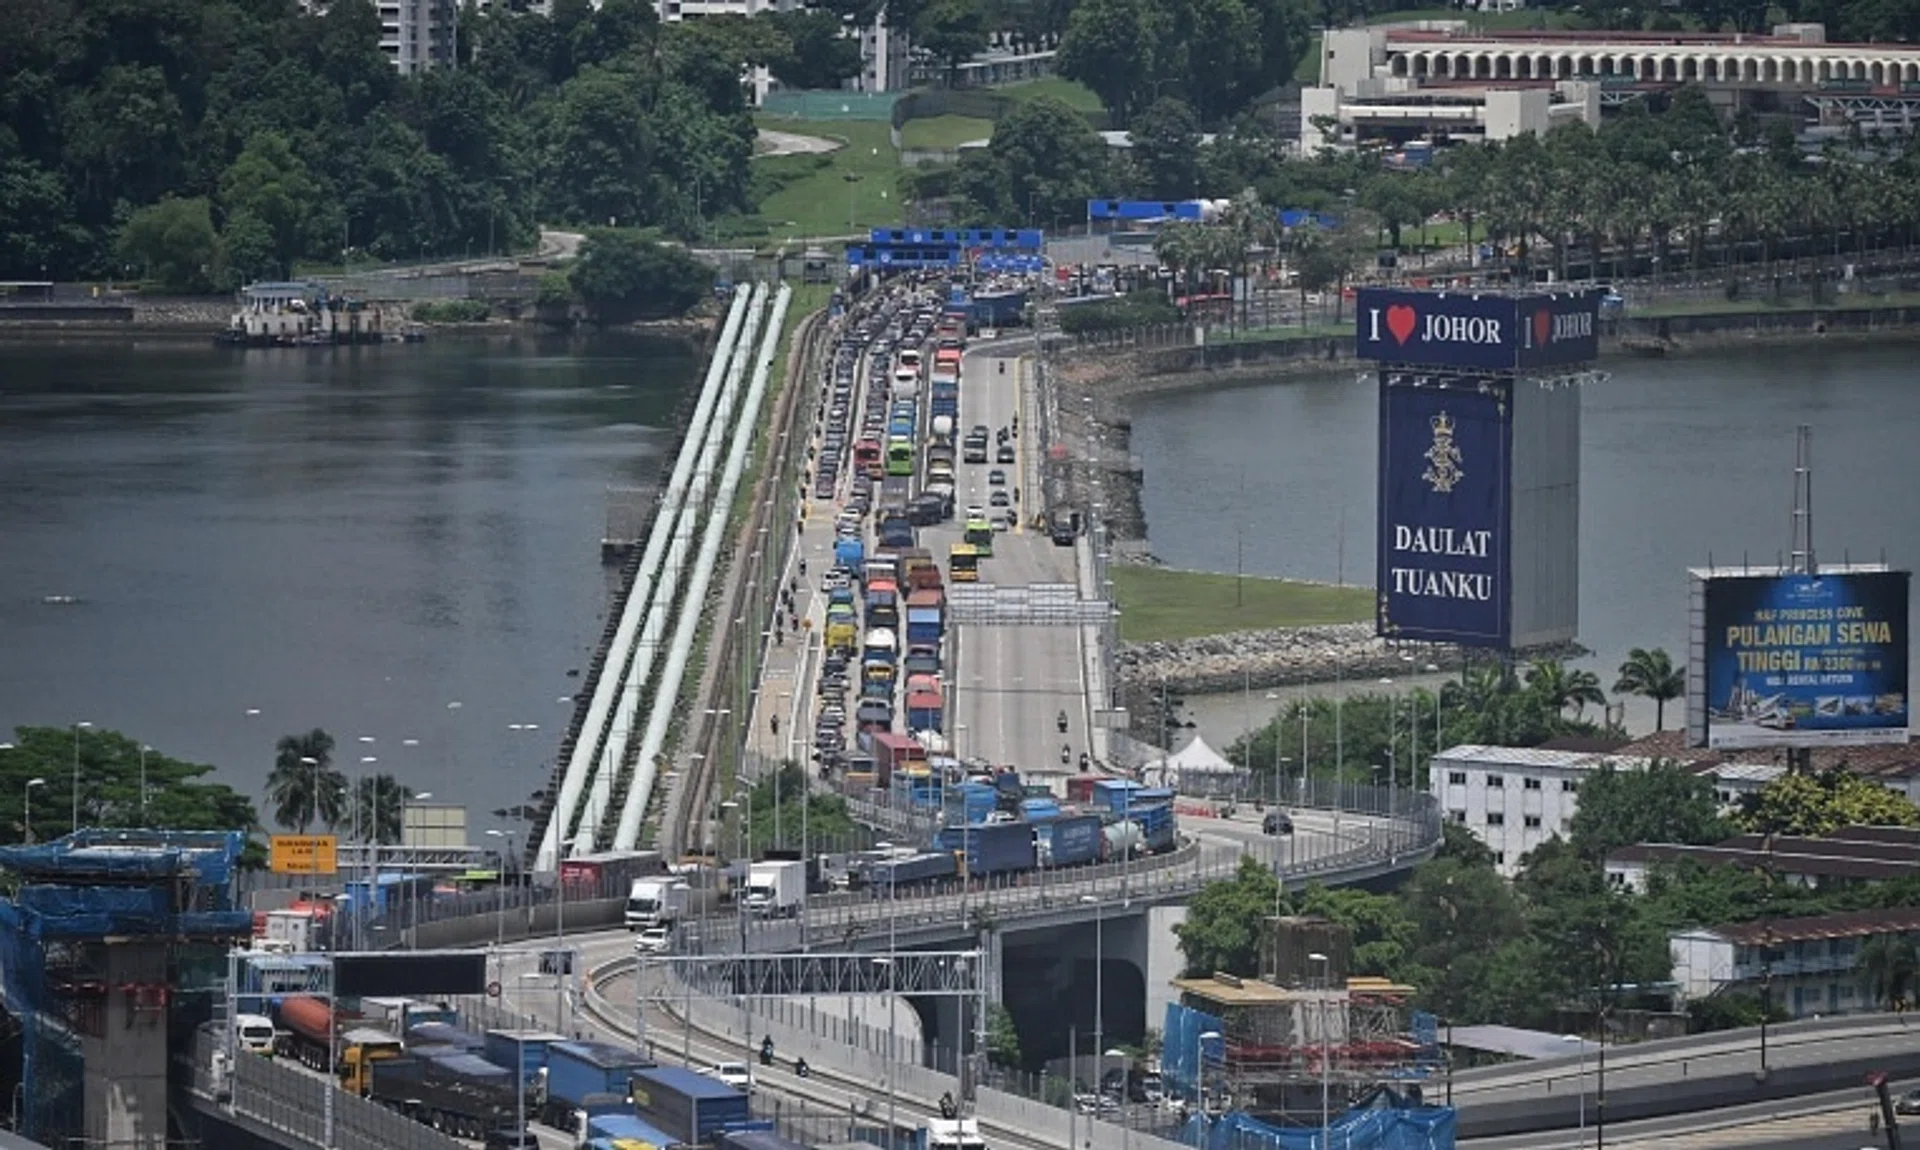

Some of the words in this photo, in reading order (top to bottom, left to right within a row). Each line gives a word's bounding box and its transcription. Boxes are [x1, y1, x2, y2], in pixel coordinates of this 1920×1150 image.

[1368, 308, 1381, 342] I
[1421, 314, 1502, 344] JOHOR
[1524, 316, 1532, 349] I
[1552, 311, 1592, 343] JOHOR
[1394, 525, 1491, 557] DAULAT
[1391, 568, 1492, 601] TUANKU
[1726, 623, 1830, 648] PULANGAN
[1837, 621, 1892, 644] SEWA
[1736, 649, 1801, 672] TINGGI
